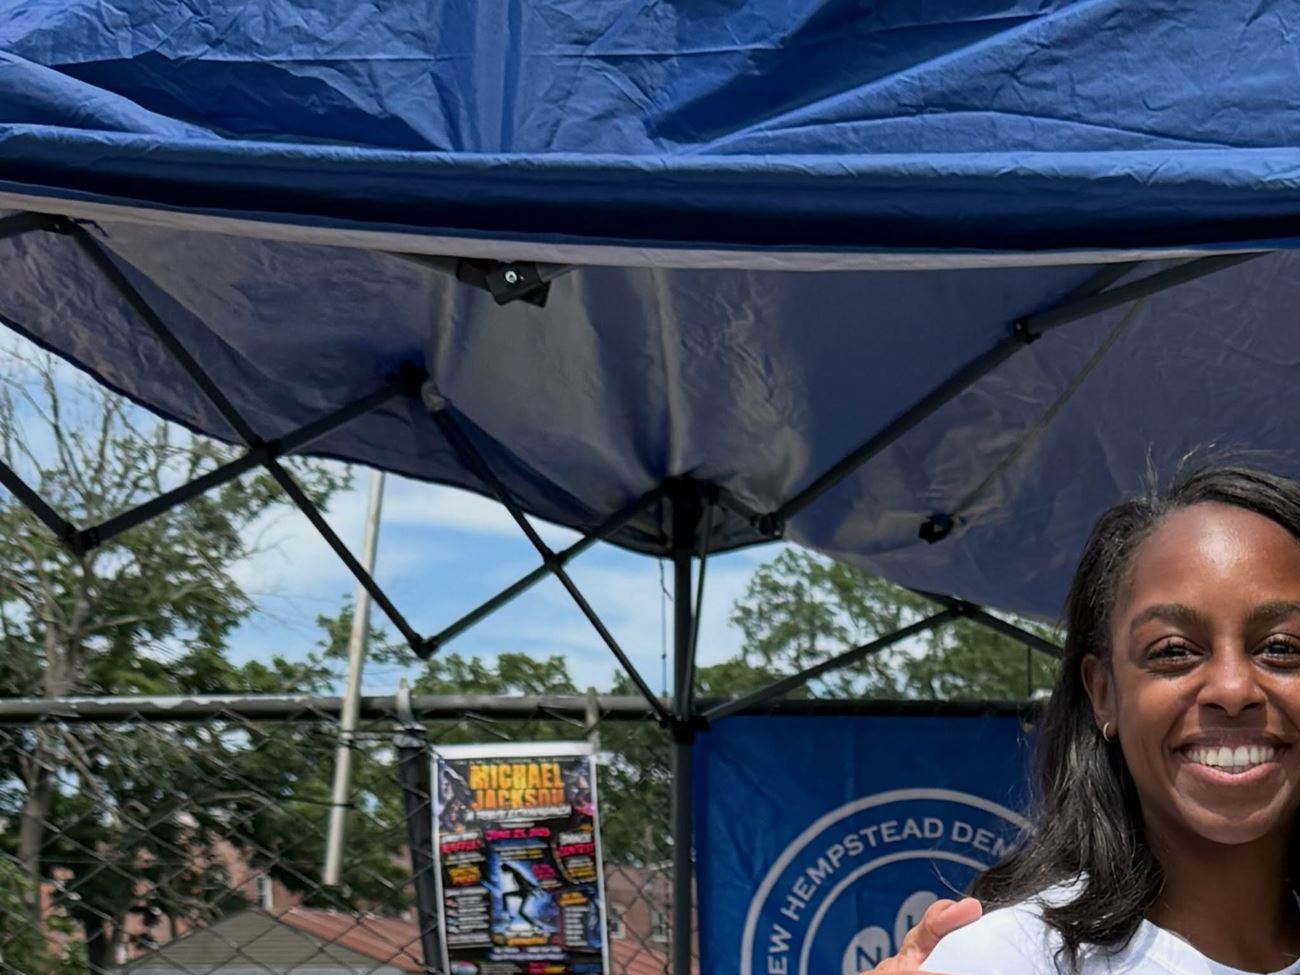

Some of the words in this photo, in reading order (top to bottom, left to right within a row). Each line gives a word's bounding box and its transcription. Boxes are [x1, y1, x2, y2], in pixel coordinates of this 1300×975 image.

[469, 762, 565, 790] MICHAEL
[469, 788, 565, 812] JACKSON
[780, 817, 944, 921] HEMPSTEAD
